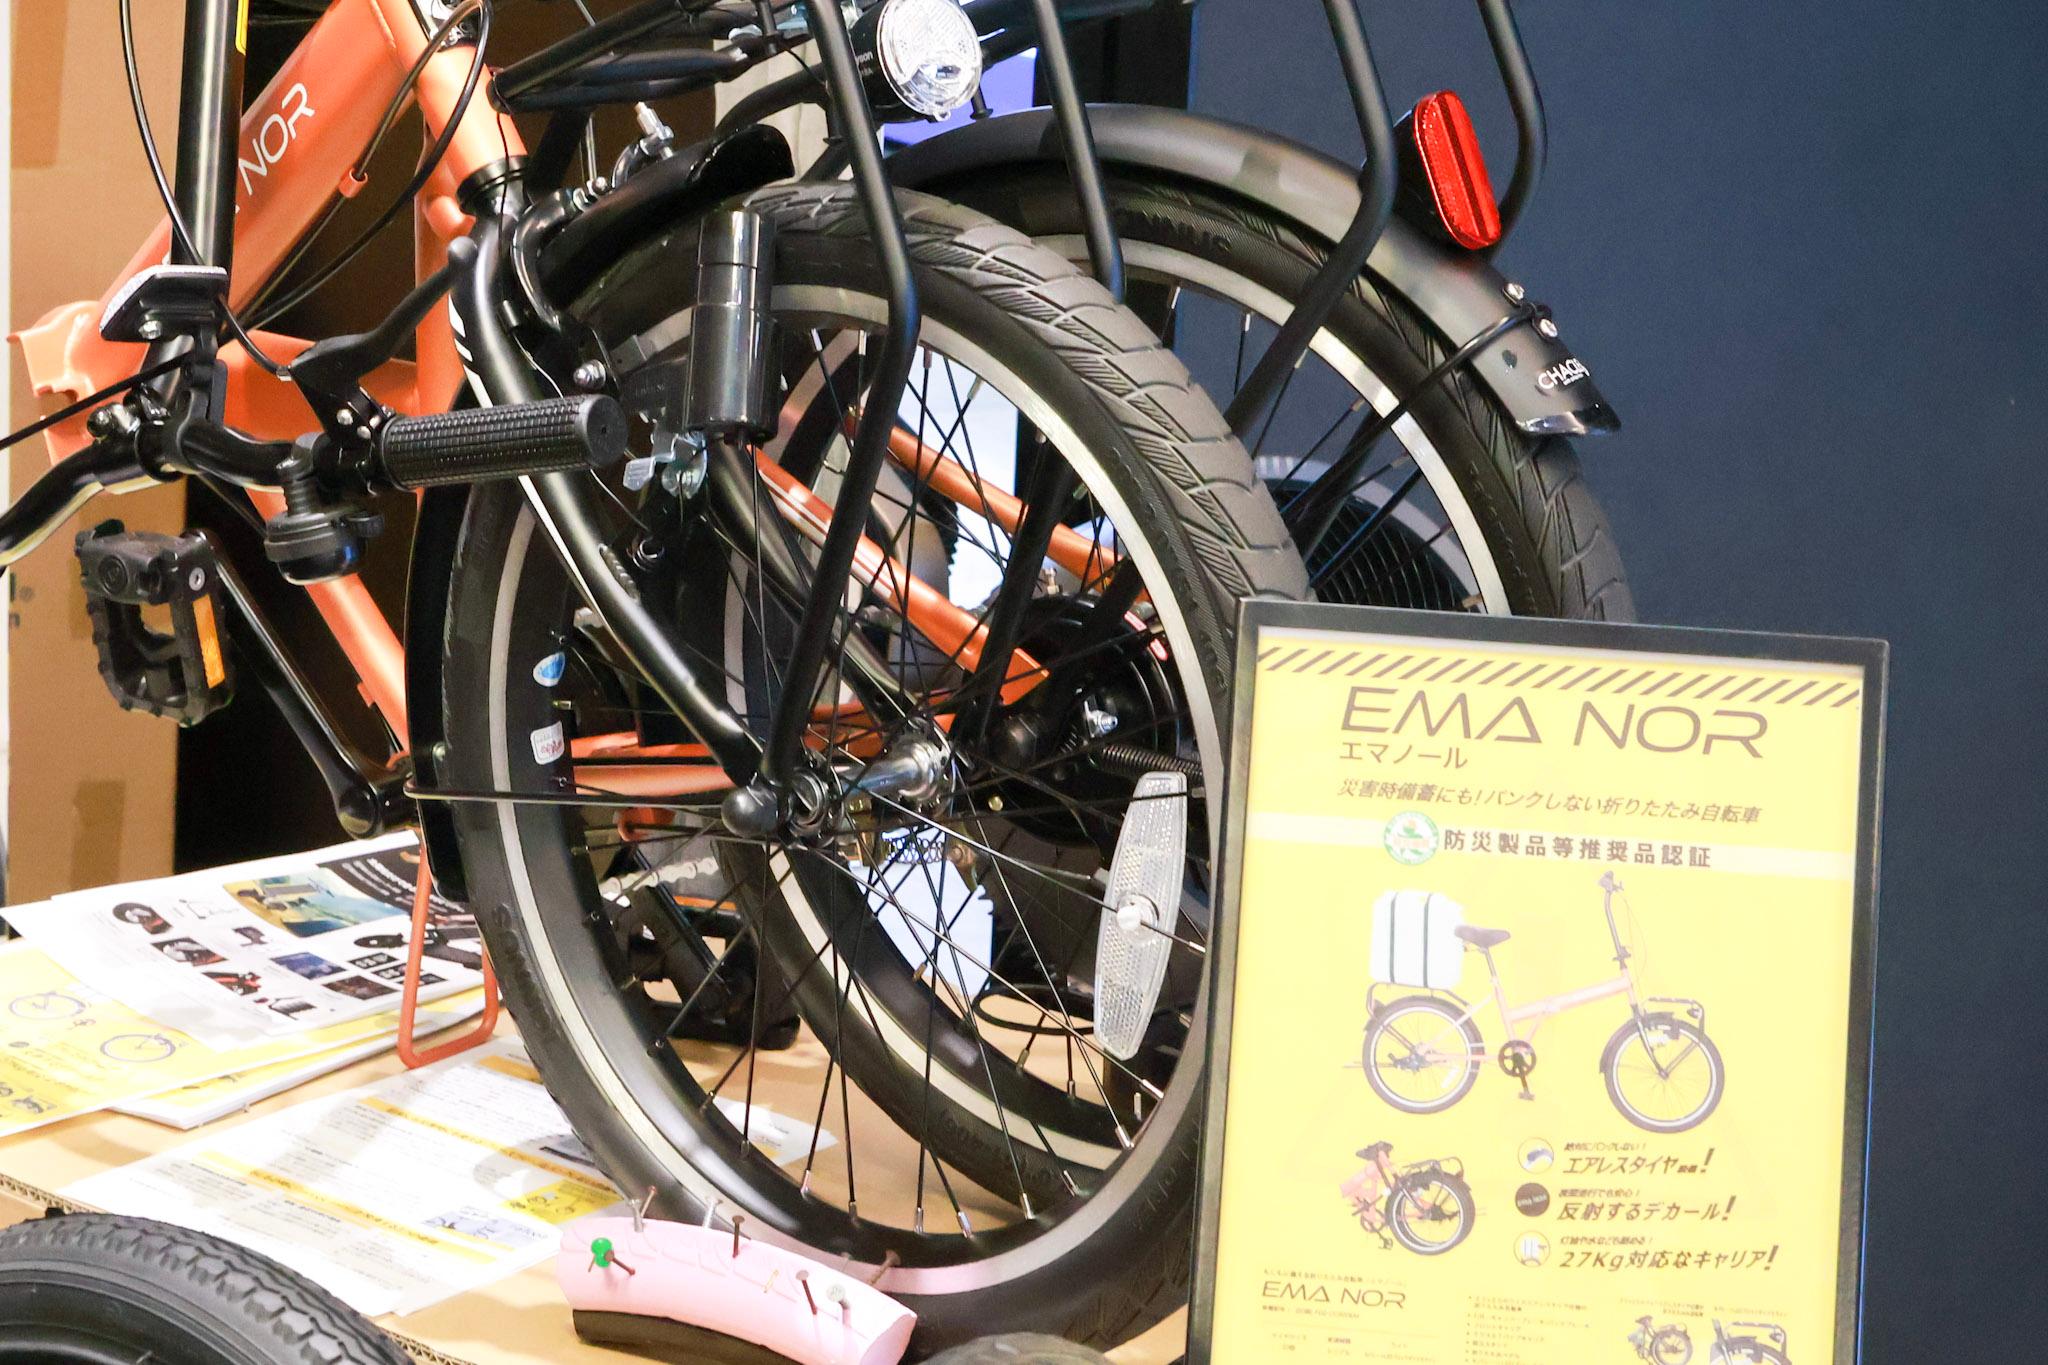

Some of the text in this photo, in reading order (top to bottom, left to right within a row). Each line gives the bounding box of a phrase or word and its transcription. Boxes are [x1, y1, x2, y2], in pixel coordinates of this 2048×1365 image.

[238, 83, 315, 196] NOR
[1340, 687, 1768, 759] EMA NOR
[1338, 743, 1468, 769] エマノール
[1443, 828, 1712, 869] 防災製品等推奨品認証
[1262, 1280, 1406, 1309] EMA NOR
